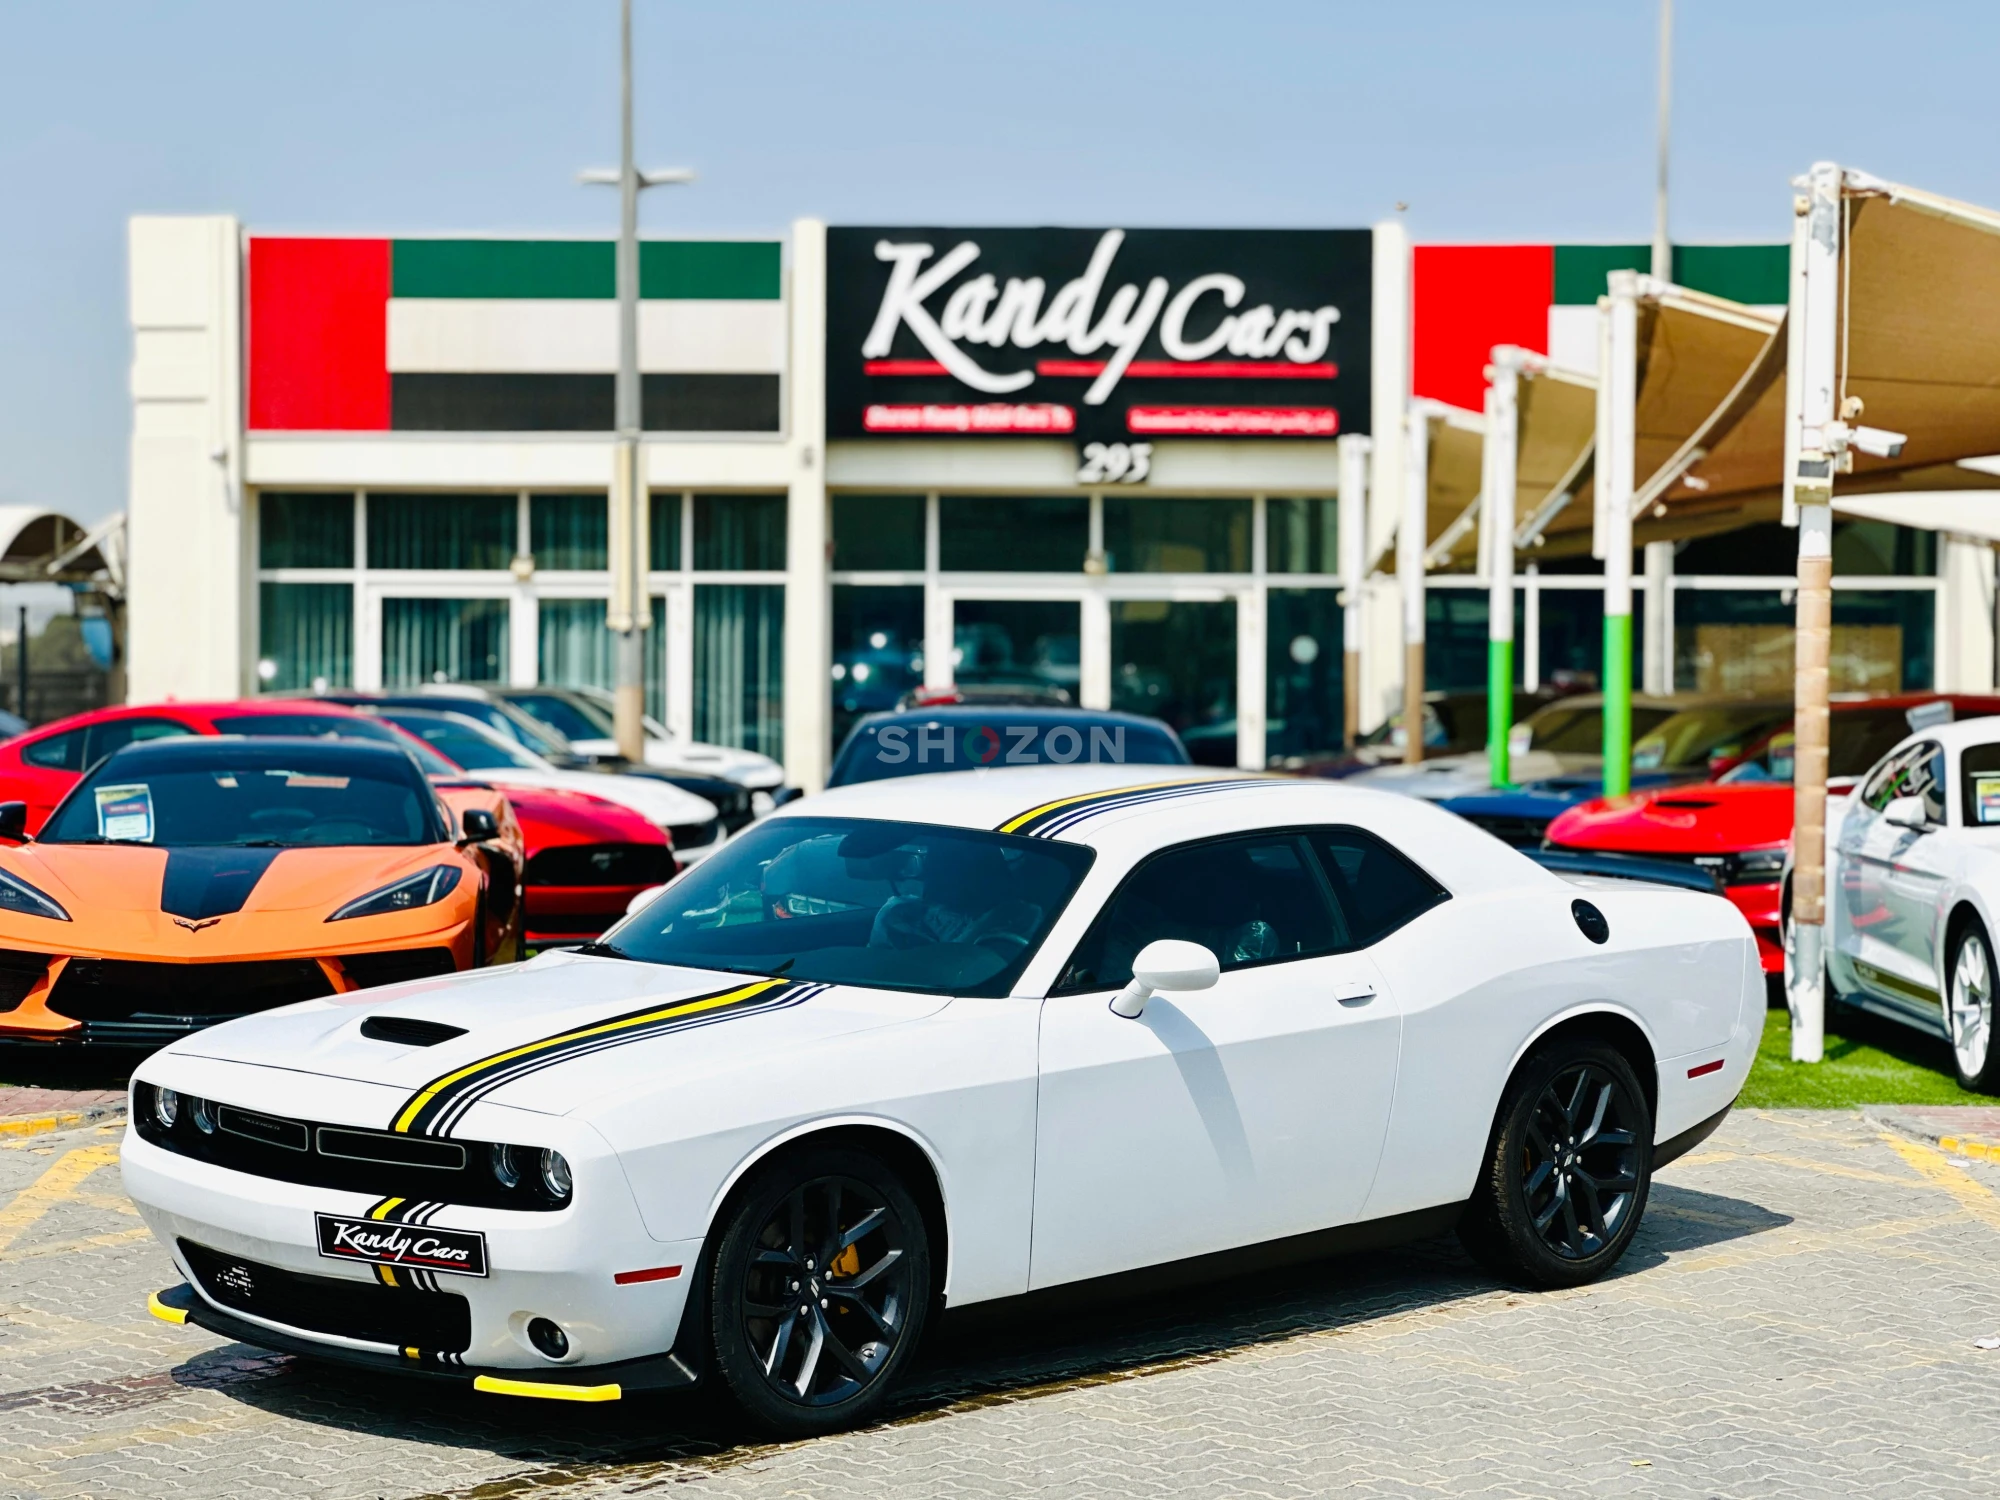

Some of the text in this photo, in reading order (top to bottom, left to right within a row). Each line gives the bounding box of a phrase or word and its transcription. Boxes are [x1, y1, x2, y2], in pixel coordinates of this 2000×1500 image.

[862, 228, 1340, 405] Kandy Cars
[1078, 442, 1153, 483] 295
[333, 1222, 469, 1262] Kandy Cars
